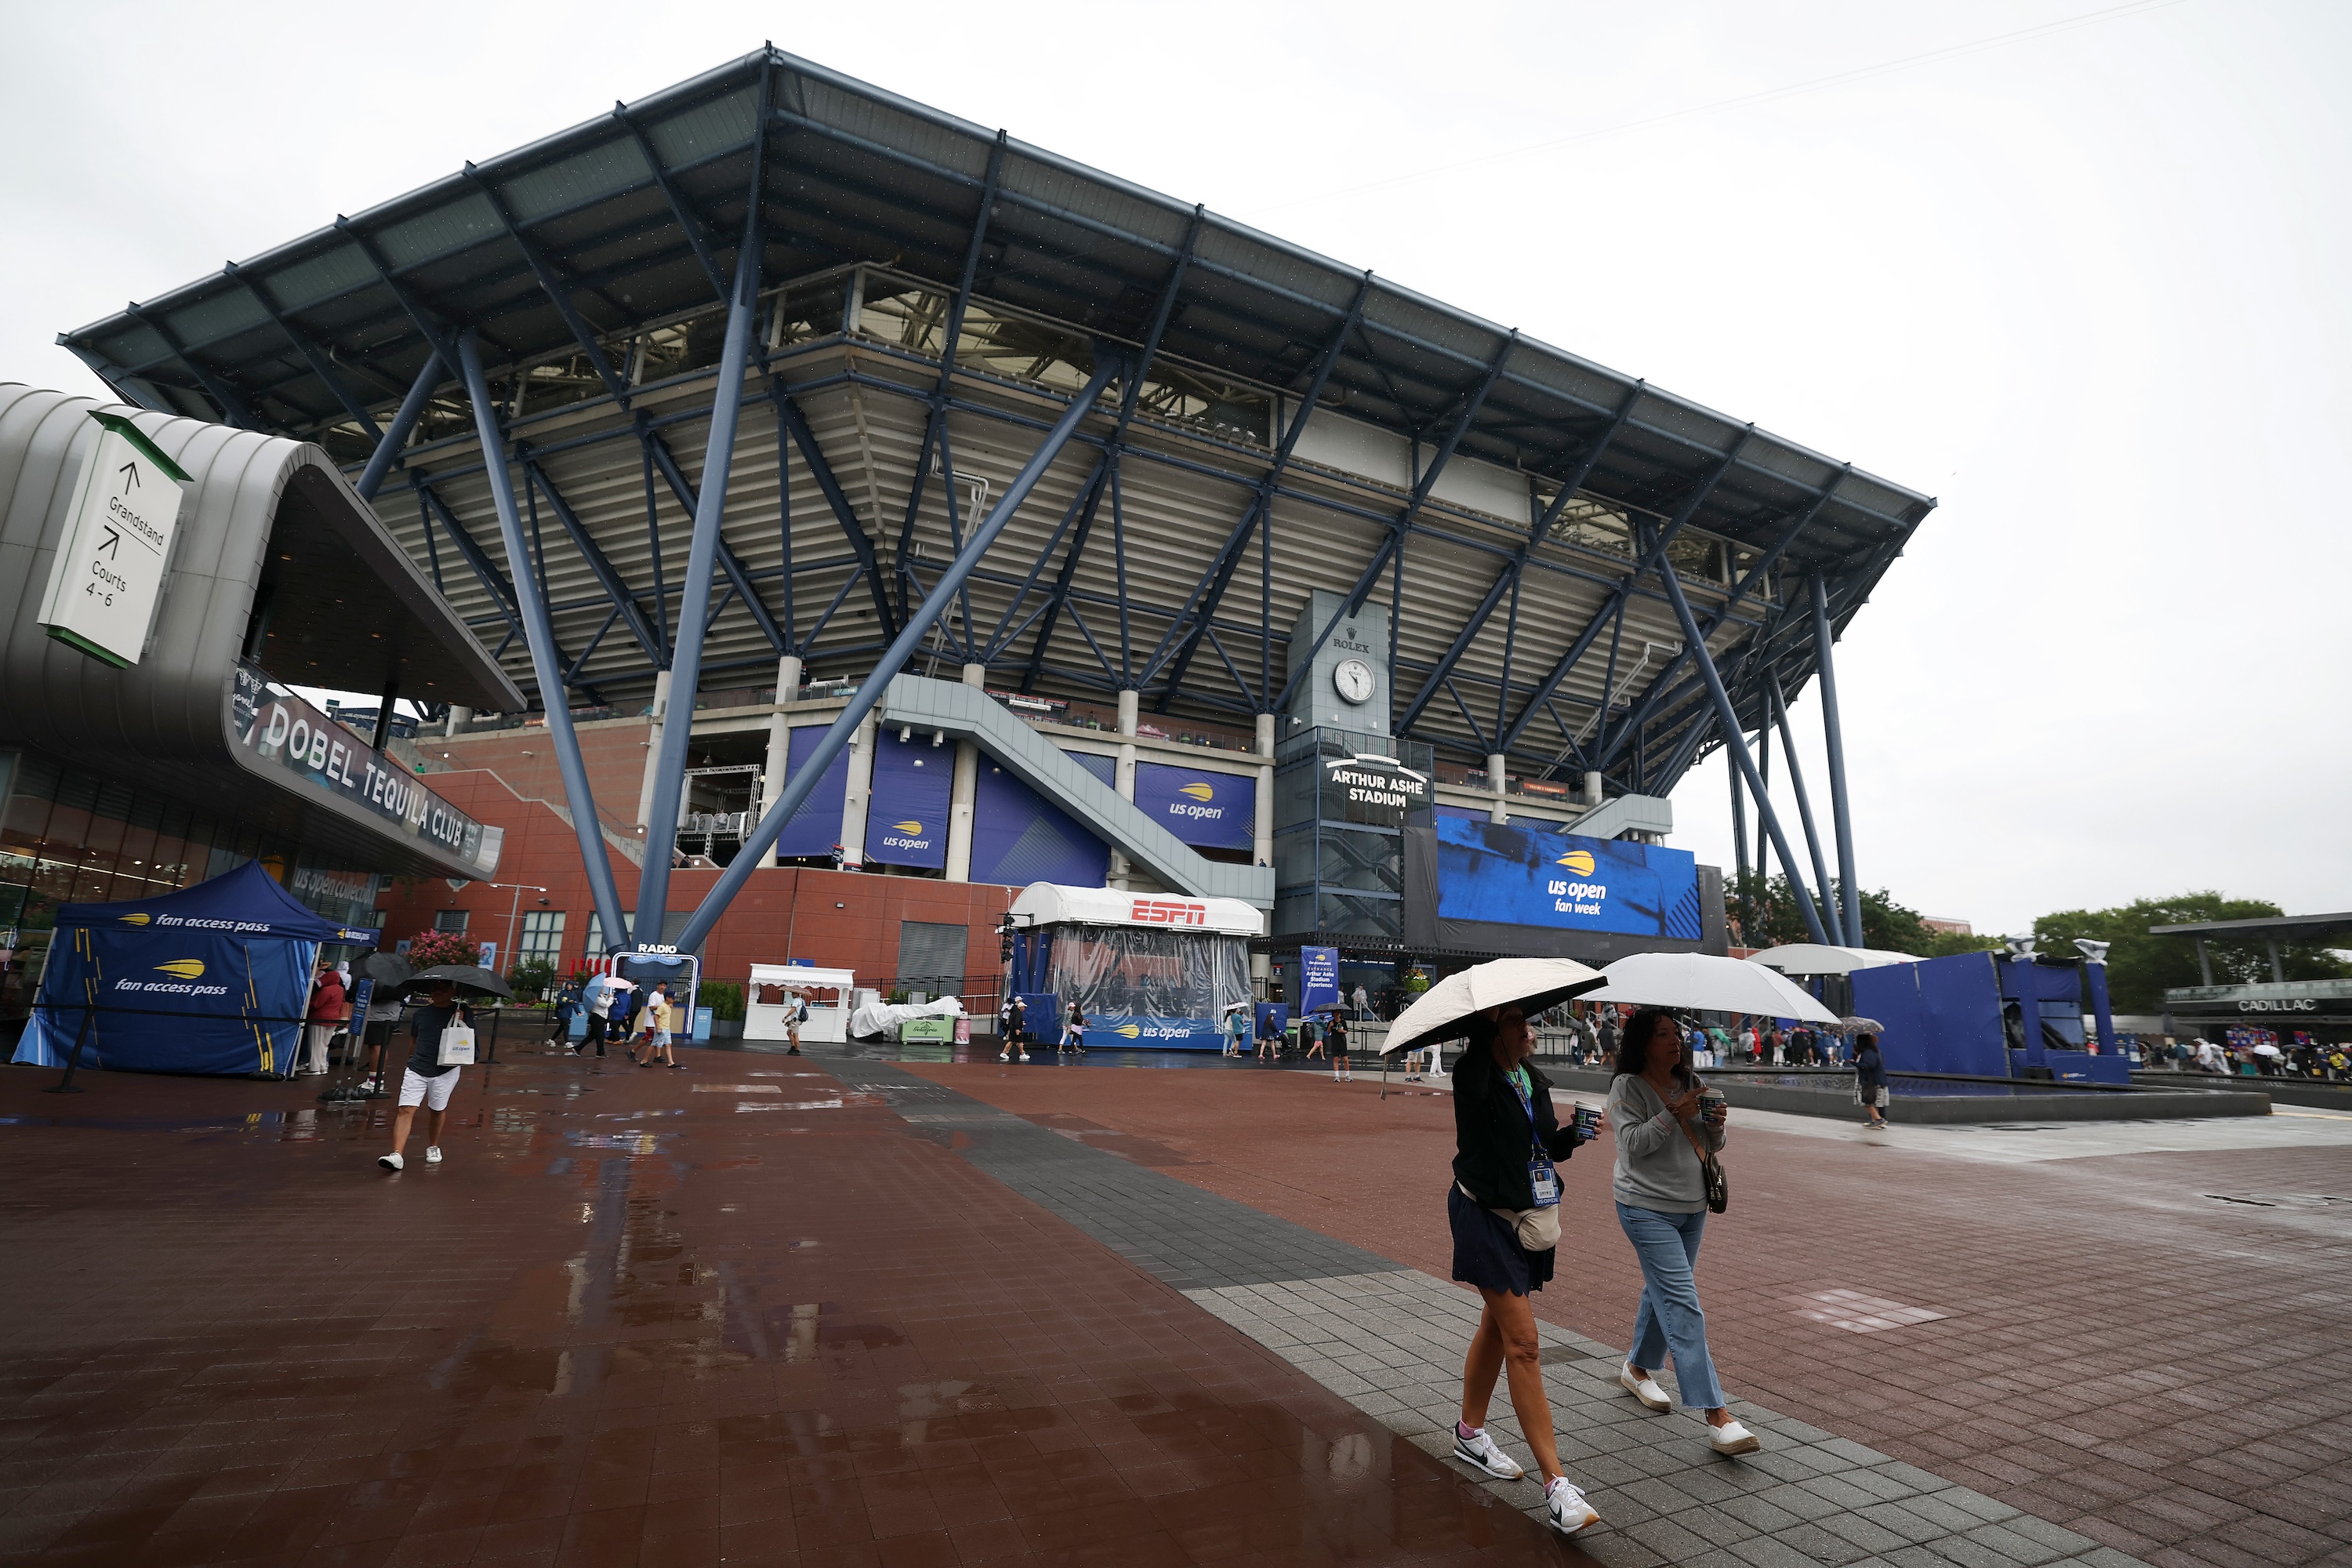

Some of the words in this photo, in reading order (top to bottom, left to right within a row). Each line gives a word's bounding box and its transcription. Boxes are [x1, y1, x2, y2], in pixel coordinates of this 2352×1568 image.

[110, 496, 165, 546] Grandstand
[93, 561, 126, 592] Courts
[1334, 638, 1370, 653] ROLEX
[266, 702, 354, 788] DOBEL
[363, 761, 428, 829] TEQUILA
[432, 808, 462, 847] CLUB
[1332, 769, 1385, 789] ARTHUR
[1389, 779, 1423, 795] ASHE
[1349, 788, 1406, 808] STADIUM
[1169, 803, 1187, 815] us
[1187, 805, 1222, 819] open
[883, 837, 898, 846] us
[898, 838, 929, 850] open
[294, 869, 310, 889] us
[309, 873, 336, 898] open
[1548, 880, 1567, 895] us
[1567, 882, 1606, 902] open
[1131, 899, 1205, 925] ESPN
[1555, 898, 1573, 913] fan
[1574, 902, 1601, 915] week
[155, 913, 182, 926] fan
[184, 918, 235, 930] access
[234, 921, 270, 932] pass
[638, 943, 677, 953] RADIO
[114, 978, 142, 991] fan
[143, 982, 193, 993] access
[191, 985, 228, 996] pass
[2238, 999, 2316, 1011] CADILLAC
[1142, 1027, 1159, 1037] us
[1159, 1027, 1190, 1040] open
